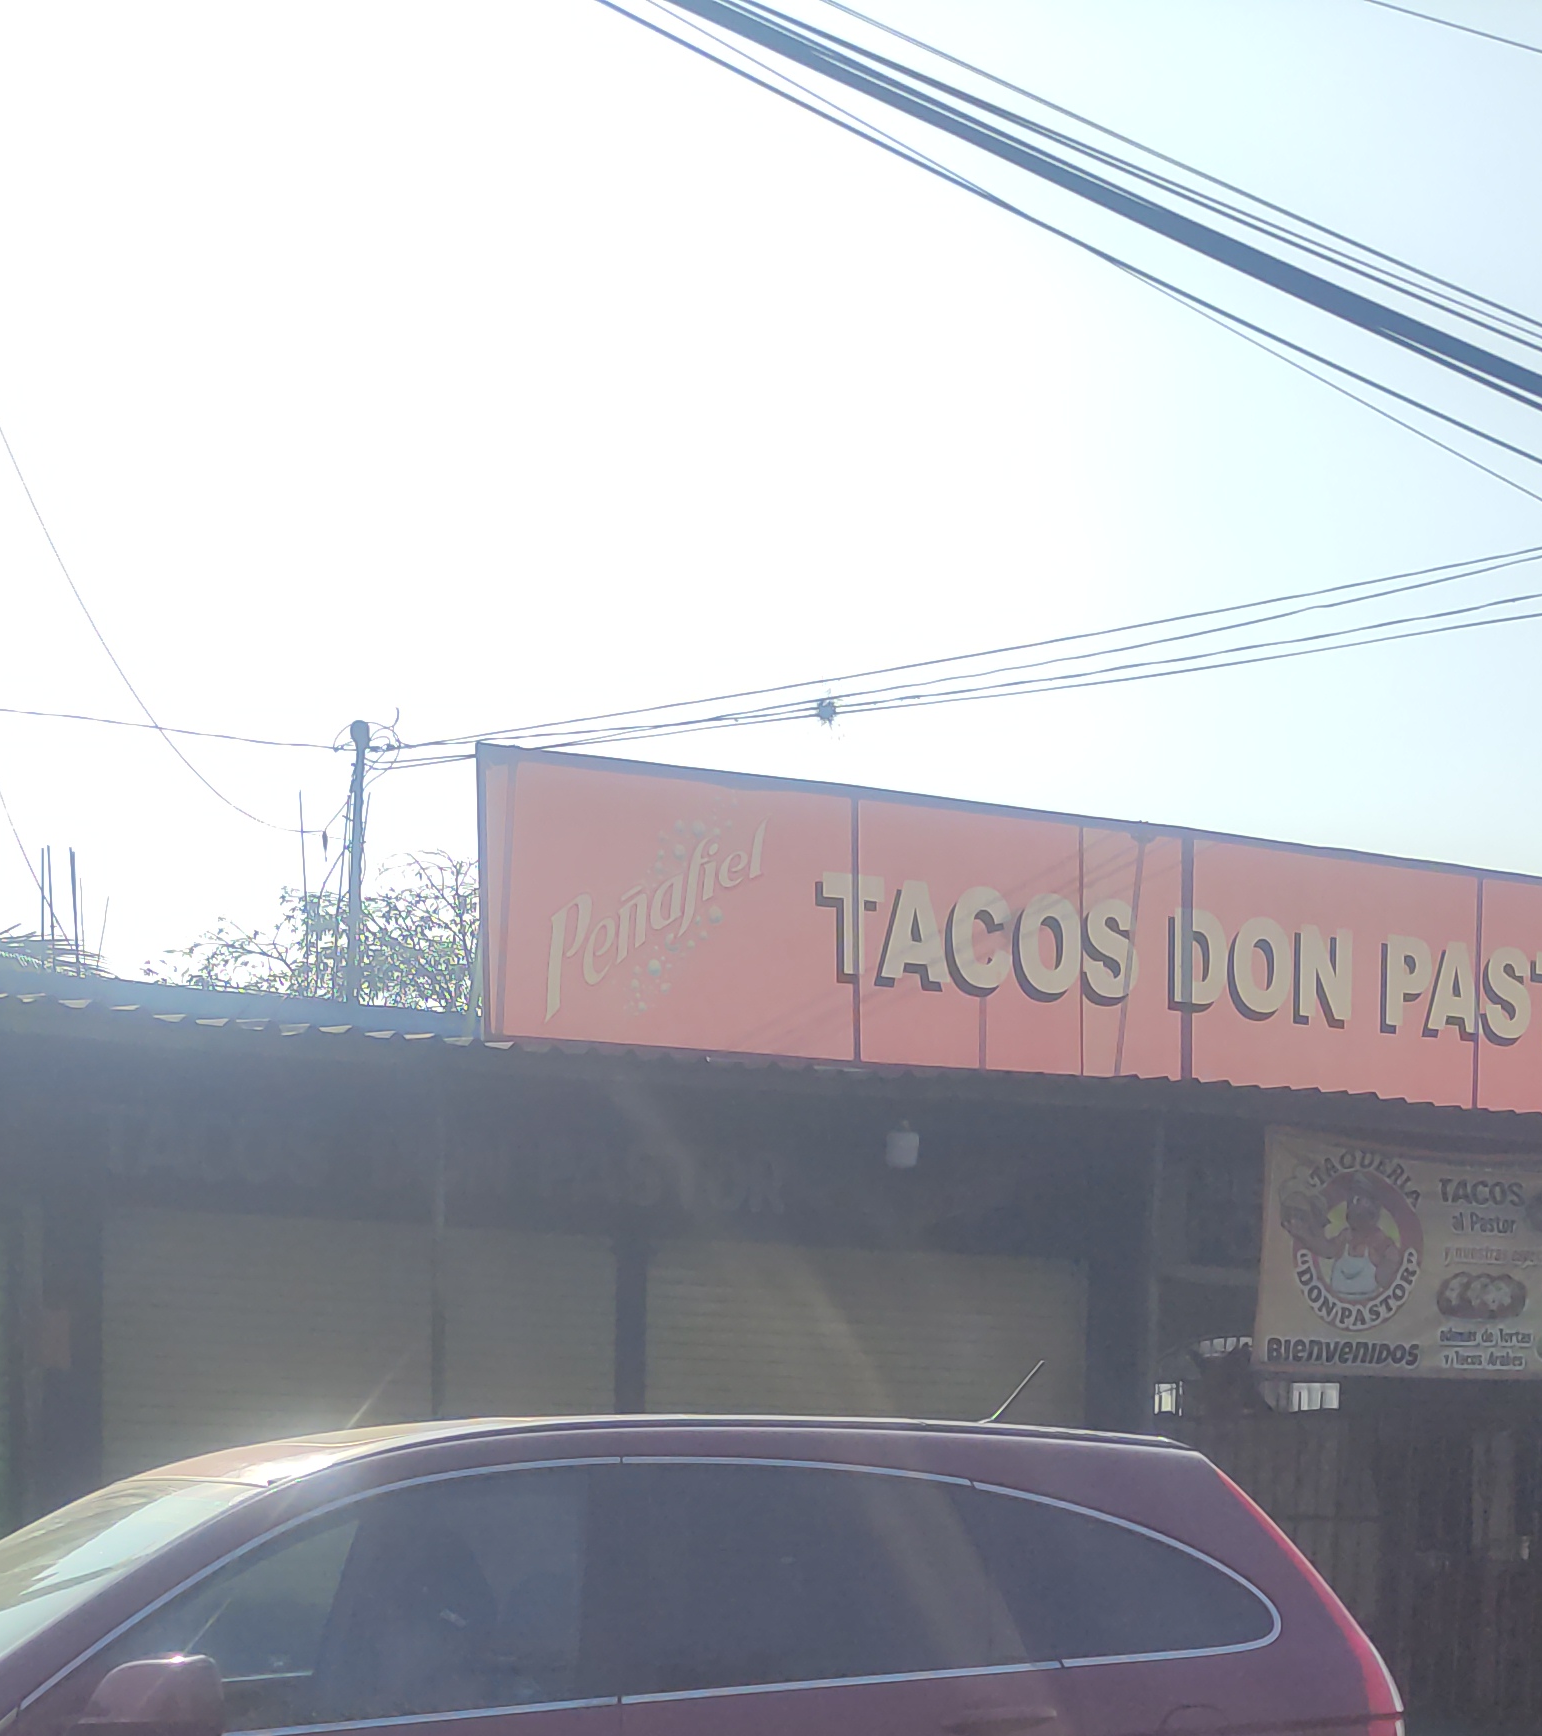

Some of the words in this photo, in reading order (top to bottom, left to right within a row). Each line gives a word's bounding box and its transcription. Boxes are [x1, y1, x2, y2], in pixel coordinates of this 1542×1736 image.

[546, 815, 770, 1023] Peñafiel
[814, 871, 1139, 1006] TACOS
[1168, 914, 1353, 1029] DON
[1438, 1177, 1526, 1208] TACOS
[1451, 1211, 1465, 1232] al
[1469, 1211, 1517, 1235] Pastor
